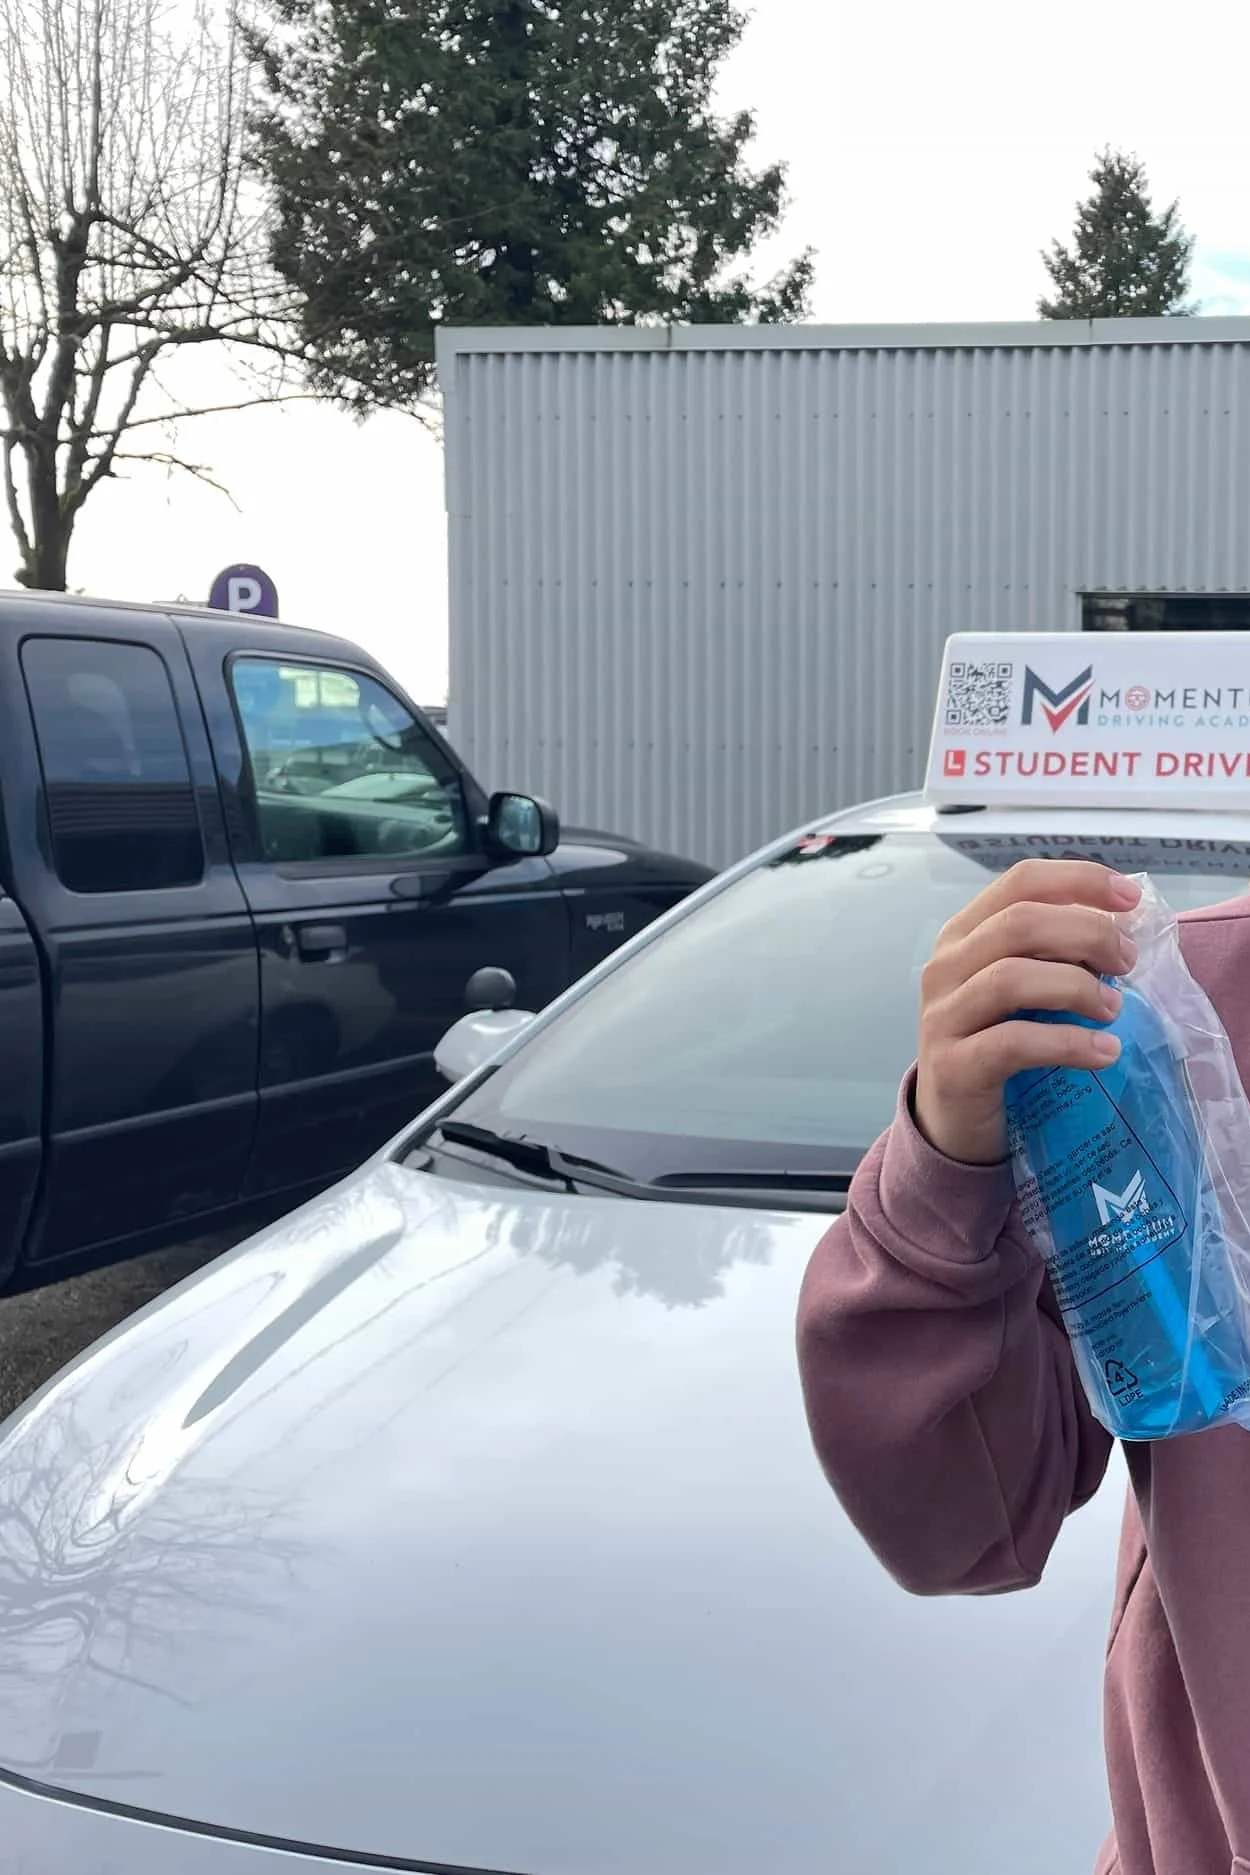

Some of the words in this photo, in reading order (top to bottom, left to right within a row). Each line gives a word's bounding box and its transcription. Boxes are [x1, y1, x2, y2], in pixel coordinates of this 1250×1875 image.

[229, 577, 260, 613] P
[1098, 714, 1184, 729] DRIVING
[974, 751, 1141, 777] STUDENT
